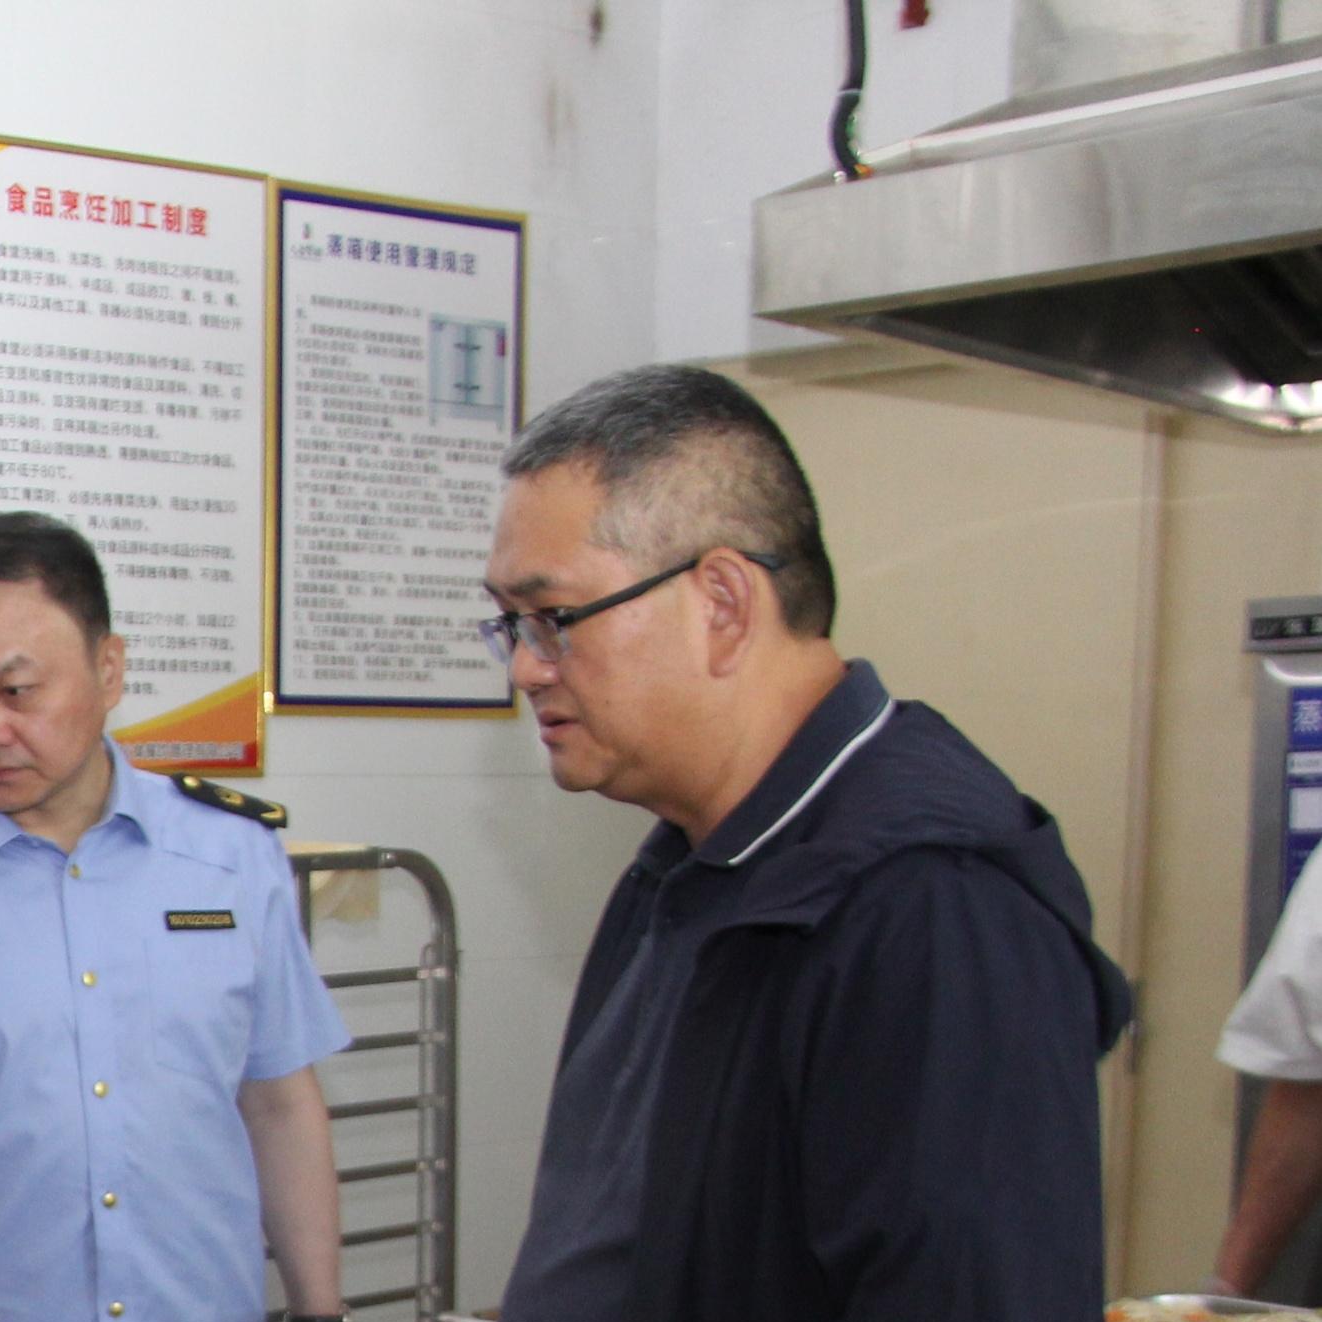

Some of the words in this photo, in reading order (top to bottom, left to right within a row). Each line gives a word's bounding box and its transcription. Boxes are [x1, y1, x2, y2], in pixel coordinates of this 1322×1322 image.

[6, 183, 207, 237] 食品烹饪加工制度
[327, 234, 477, 275] 蒸箱使用管理规定
